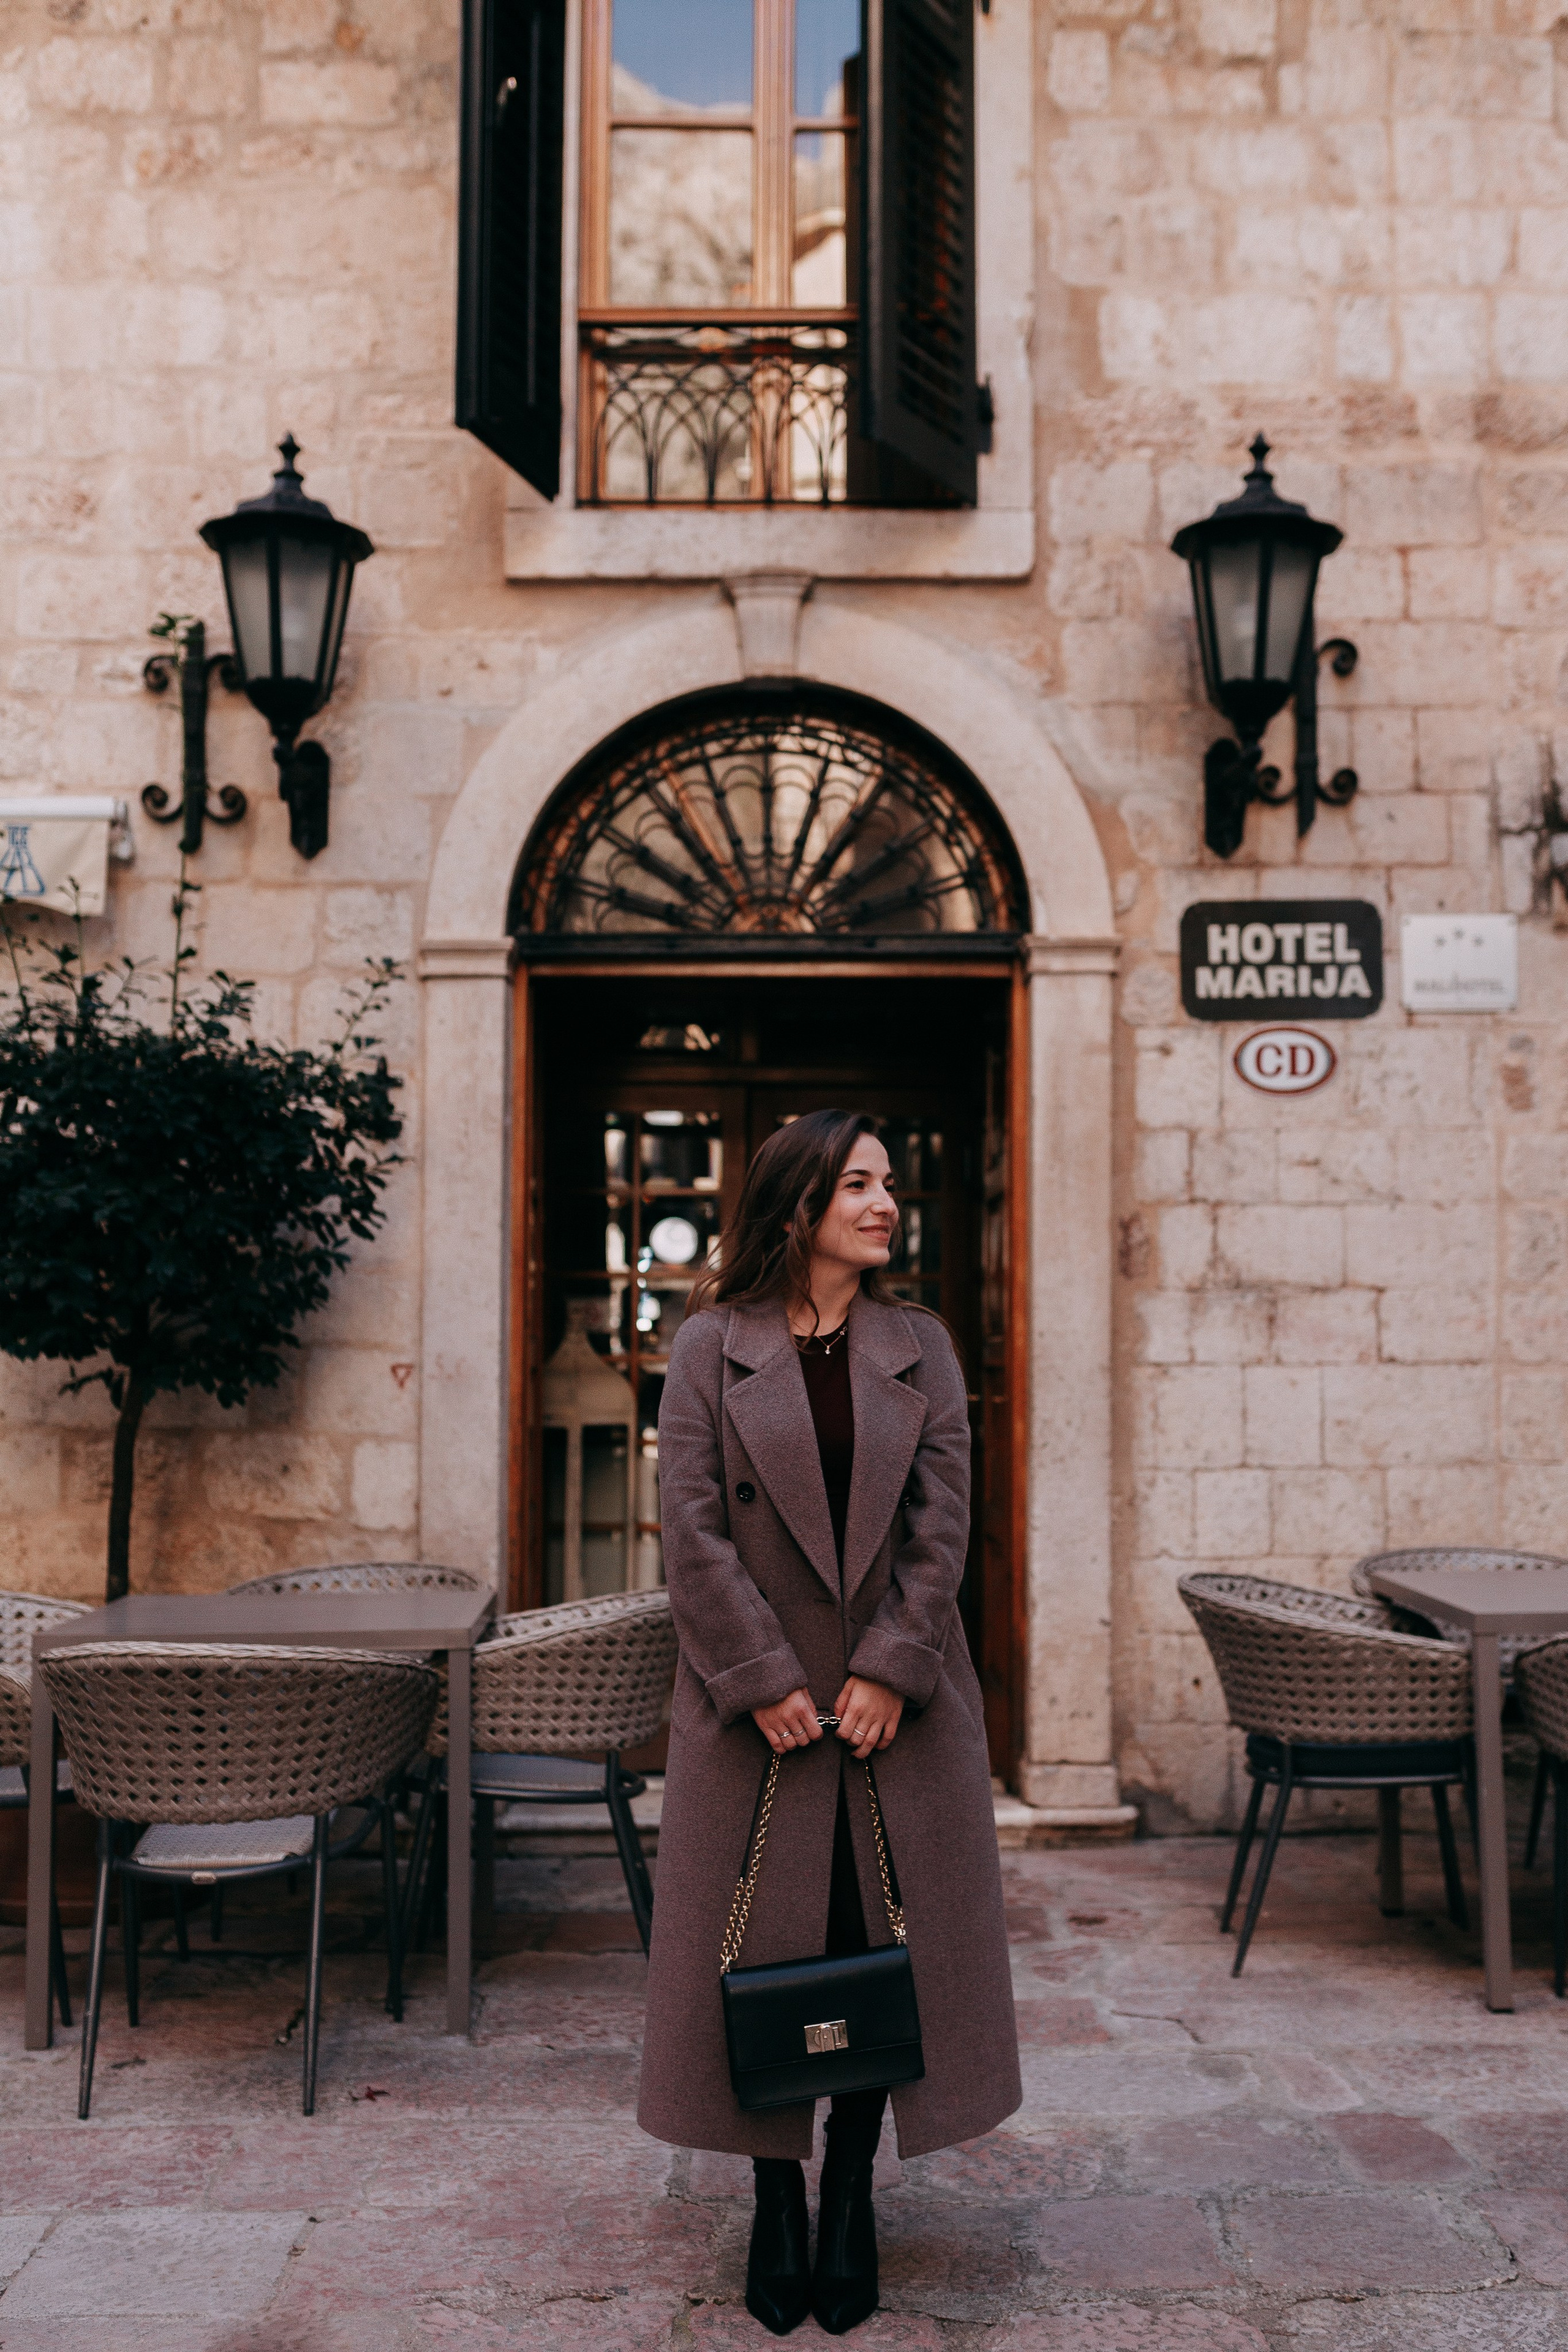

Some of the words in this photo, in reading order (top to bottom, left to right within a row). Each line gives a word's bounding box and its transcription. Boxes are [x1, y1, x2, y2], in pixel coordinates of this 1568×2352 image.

[1207, 923, 1361, 965] HOTEL
[1195, 965, 1372, 999] MARIJA
[1255, 1044, 1317, 1077] CD
